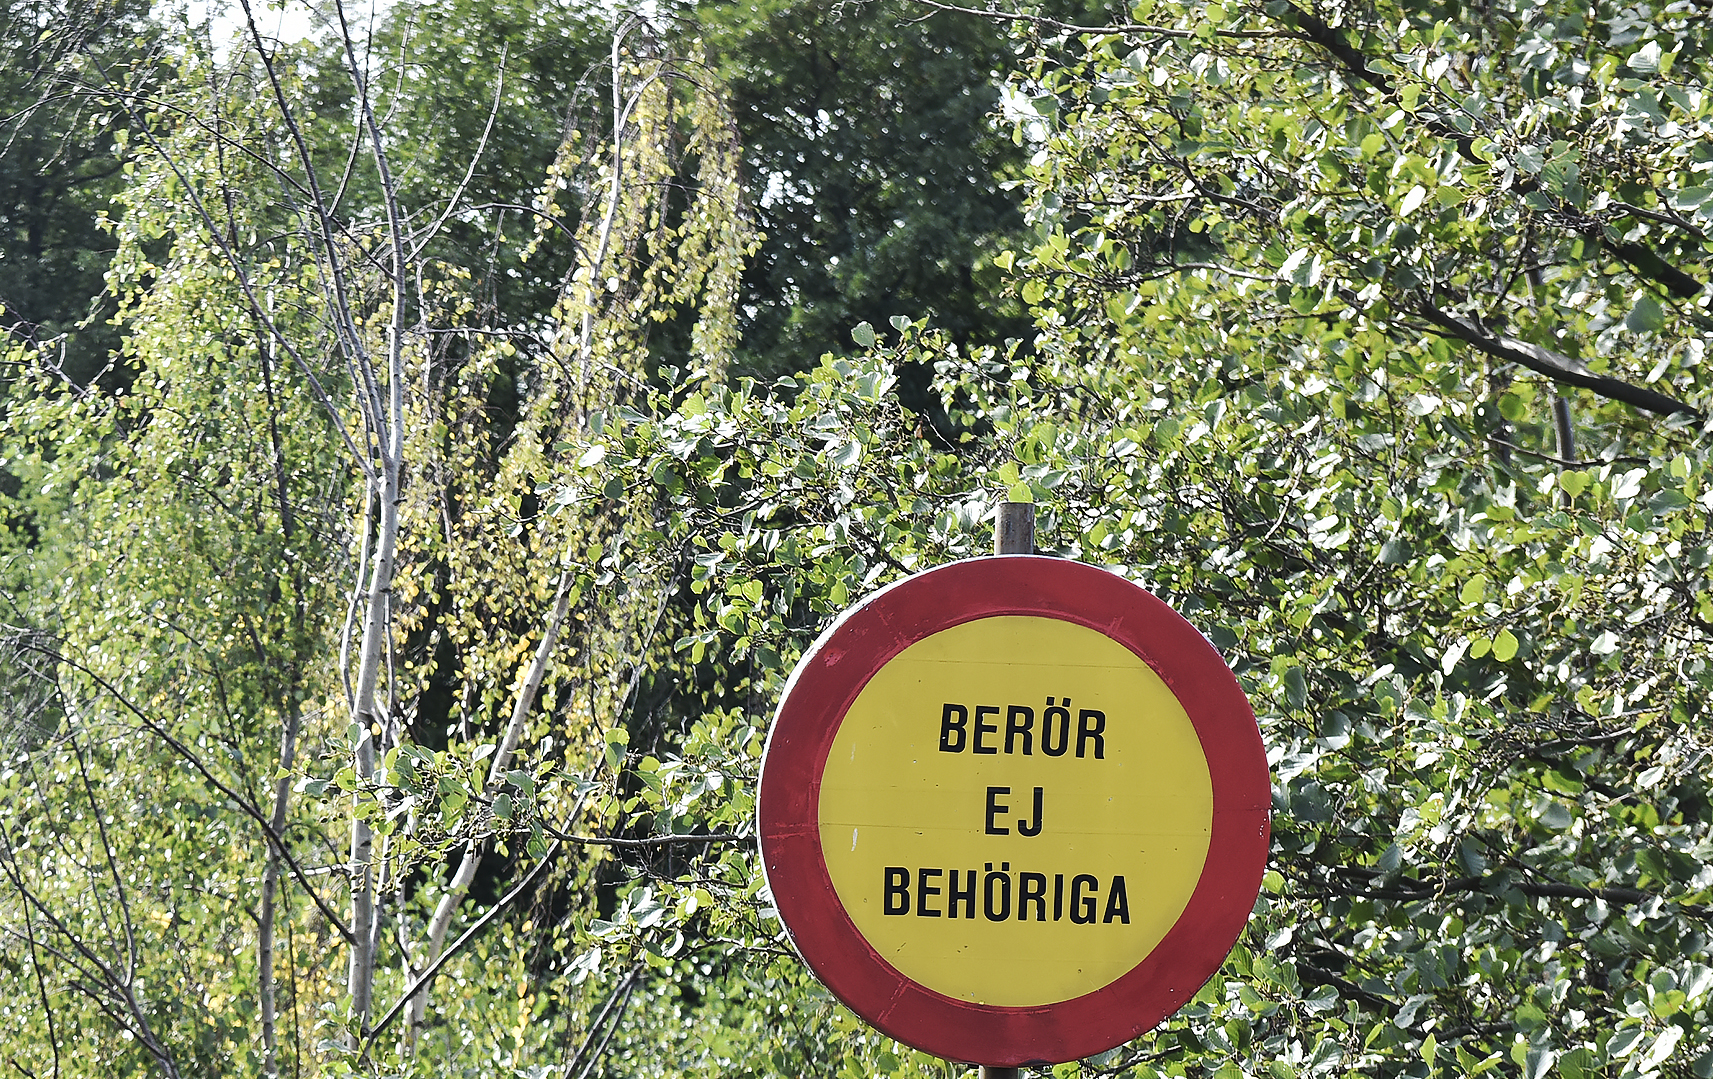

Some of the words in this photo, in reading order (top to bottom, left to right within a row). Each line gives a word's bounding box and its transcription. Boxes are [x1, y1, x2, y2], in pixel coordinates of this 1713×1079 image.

[938, 696, 1106, 760] BERÖR
[984, 786, 1044, 838] EJ
[883, 861, 1131, 925] BEHÖRIGA
